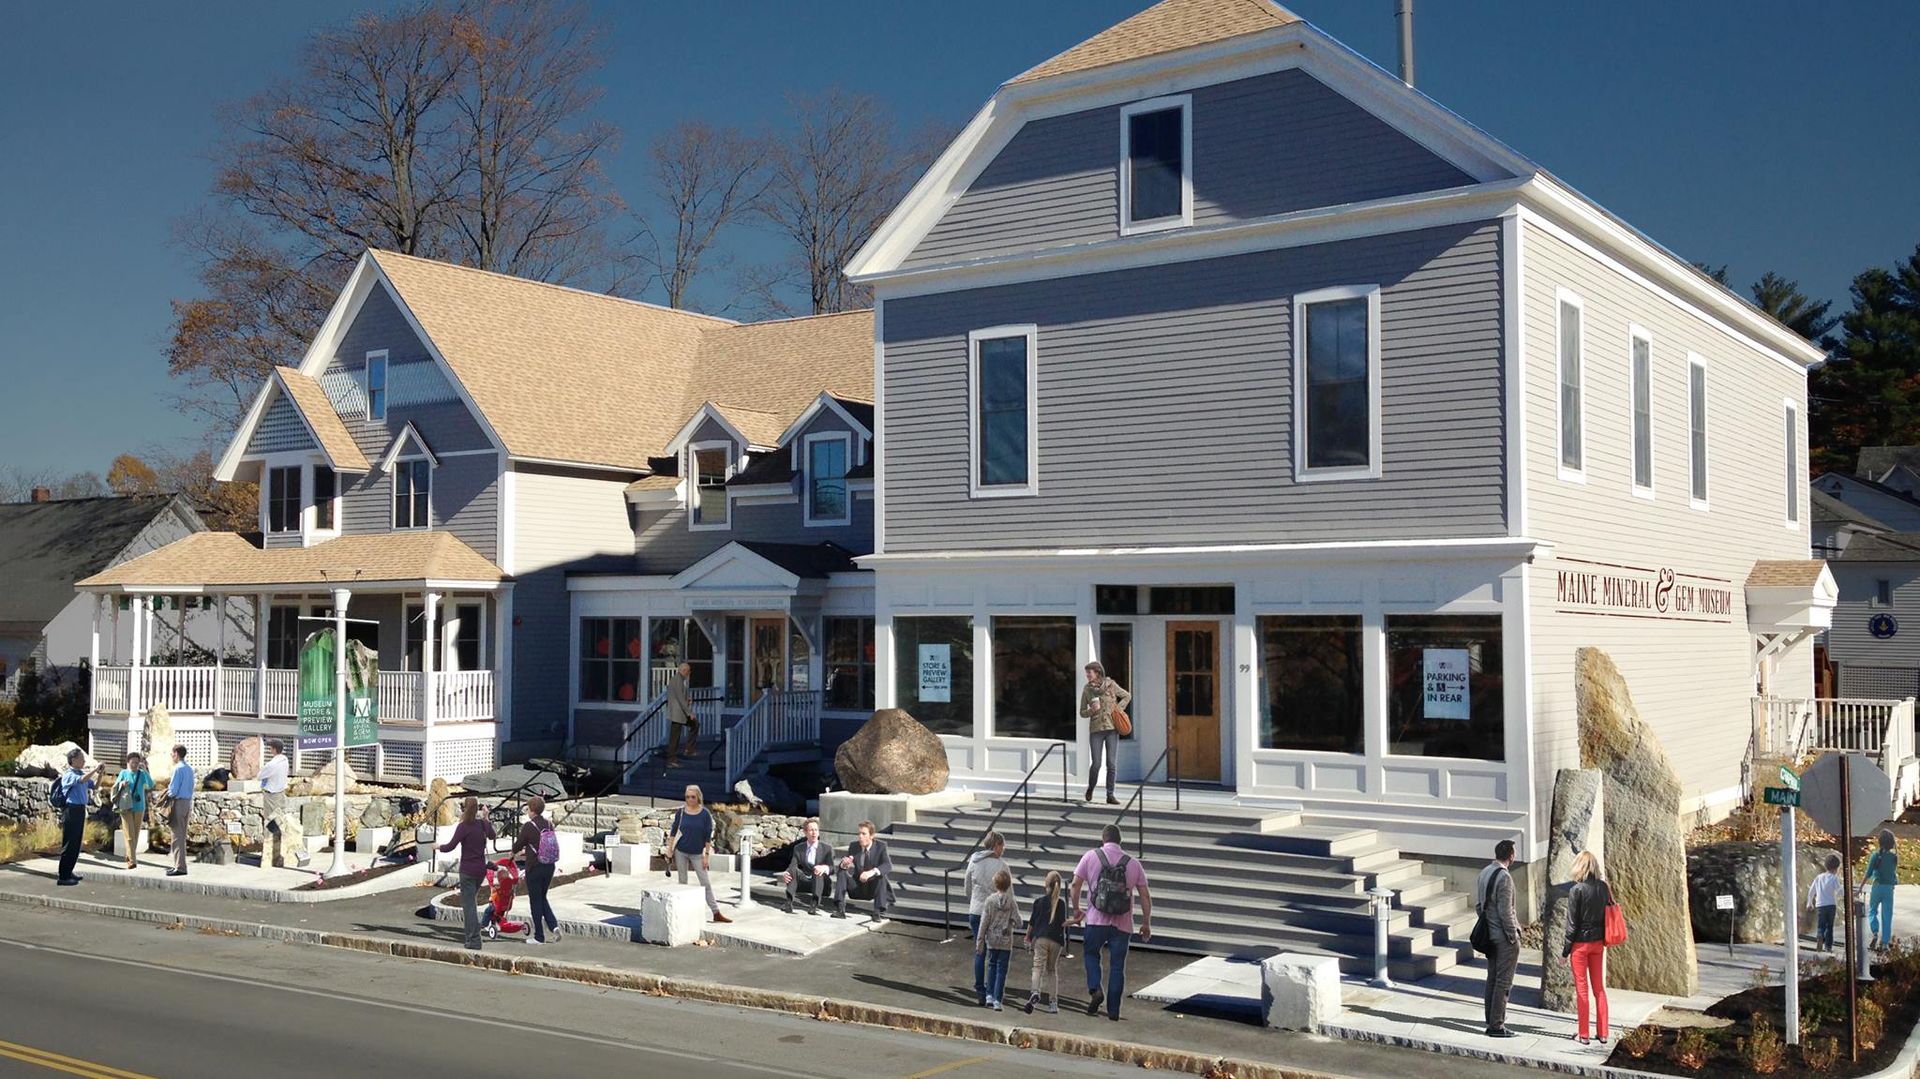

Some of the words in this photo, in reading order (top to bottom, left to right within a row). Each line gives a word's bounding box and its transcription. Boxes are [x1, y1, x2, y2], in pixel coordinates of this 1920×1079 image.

[1557, 570, 1597, 605] MAINE
[1603, 576, 1651, 609] MINERAL
[1655, 567, 1675, 613] &
[1675, 584, 1694, 612] GEM
[1698, 587, 1731, 615] MUSEUM
[1239, 664, 1250, 673] 99
[1426, 673, 1466, 681] PARKING
[1427, 682, 1434, 691] &
[1427, 694, 1437, 702] IN
[1440, 694, 1462, 703] REAR
[303, 700, 332, 708] MUSEUM
[303, 716, 333, 724] PREVIEW
[303, 724, 332, 732] GALLERY
[1771, 790, 1797, 804] MAIN
